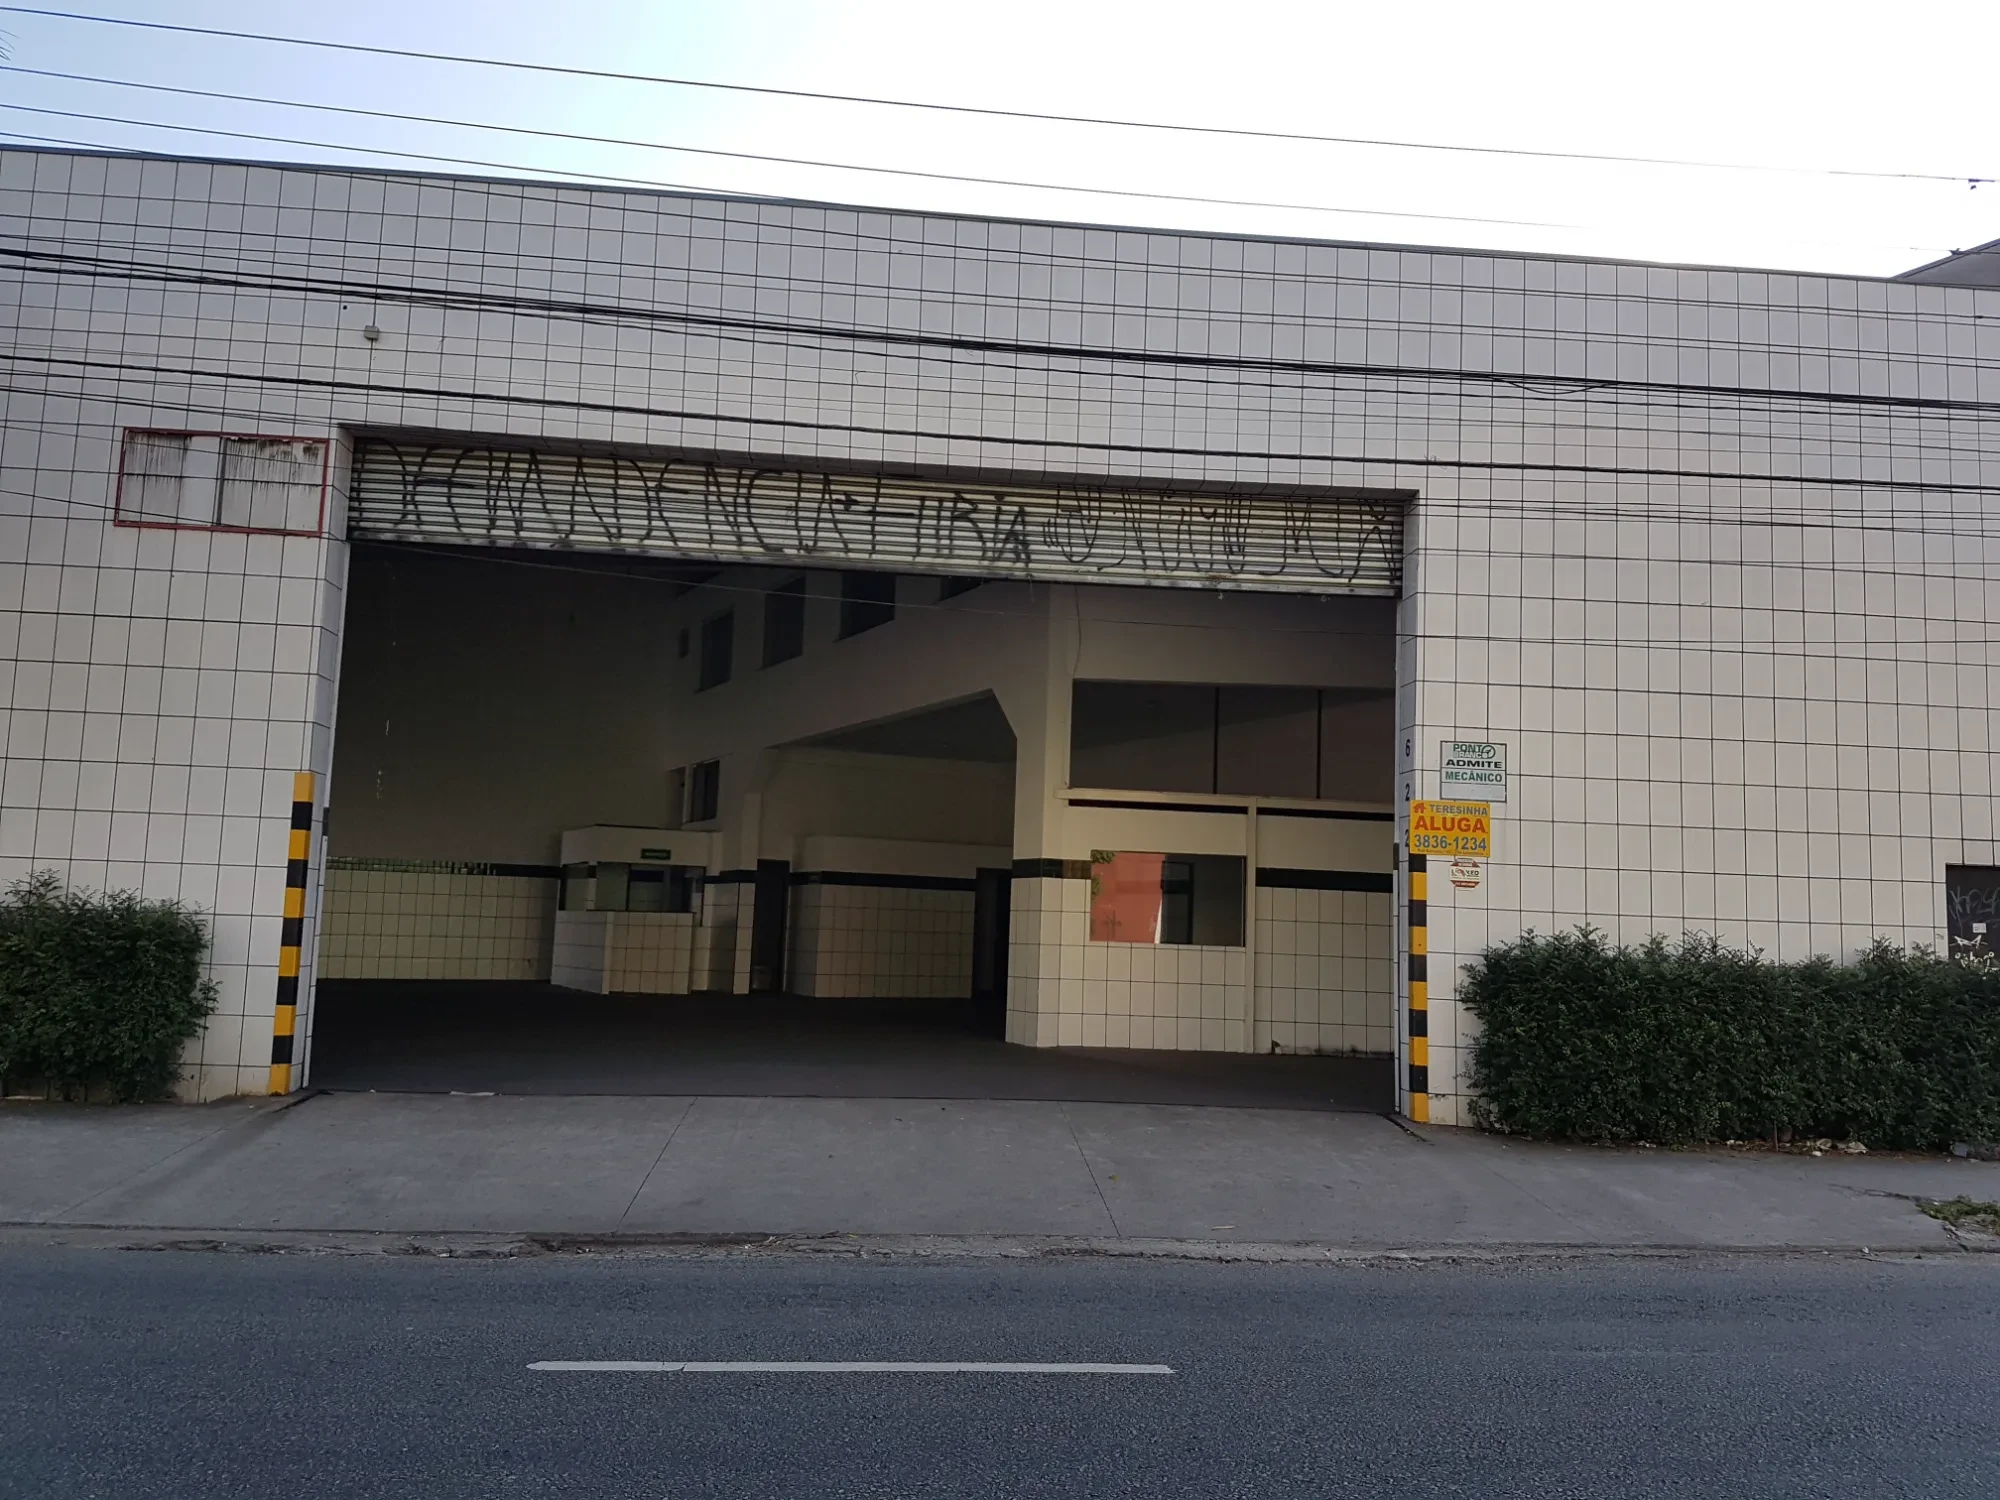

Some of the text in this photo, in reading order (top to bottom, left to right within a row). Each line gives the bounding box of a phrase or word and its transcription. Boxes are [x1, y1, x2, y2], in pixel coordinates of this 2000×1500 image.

[1445, 759, 1503, 769] ADMITE
[1445, 770, 1503, 783] MECÂNICO
[1429, 803, 1488, 816] TERESINHA
[1414, 815, 1486, 833] ALUGA
[1414, 833, 1487, 851] 3836-1234
